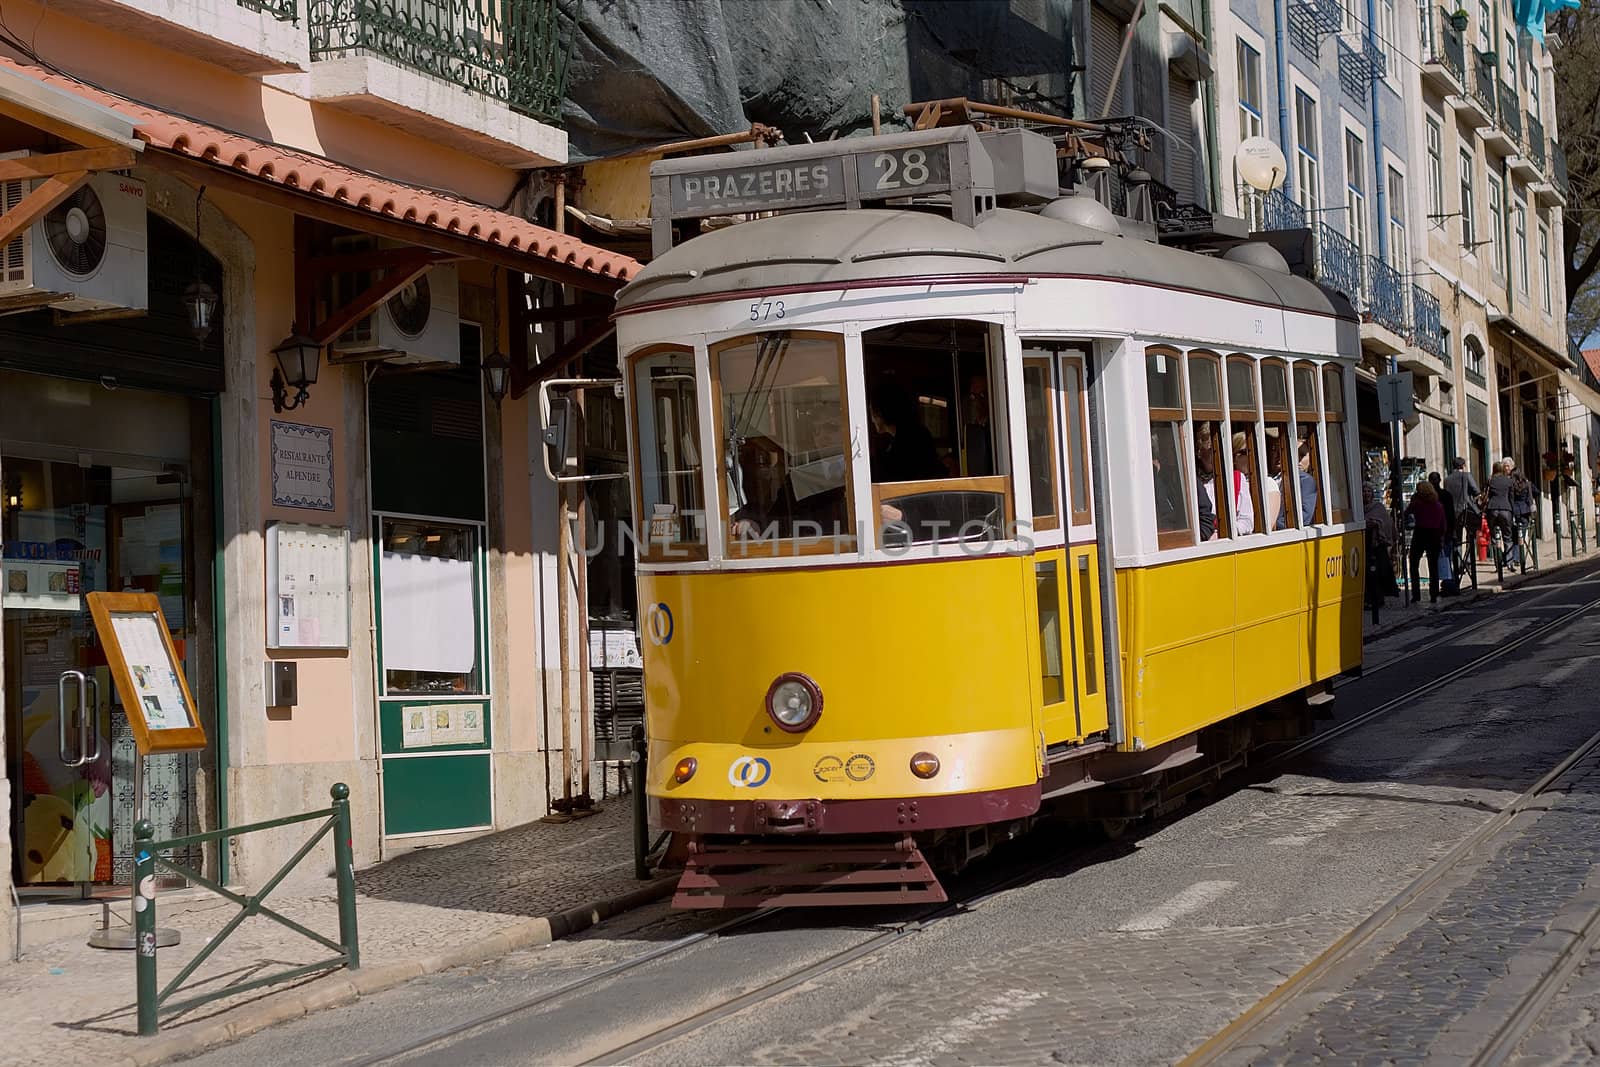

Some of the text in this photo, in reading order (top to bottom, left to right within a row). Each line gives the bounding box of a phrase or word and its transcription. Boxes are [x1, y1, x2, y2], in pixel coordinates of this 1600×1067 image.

[685, 164, 829, 201] PRAZERES
[874, 149, 930, 190] 28
[750, 301, 785, 321] 573
[279, 449, 326, 465] RESTAURANTE
